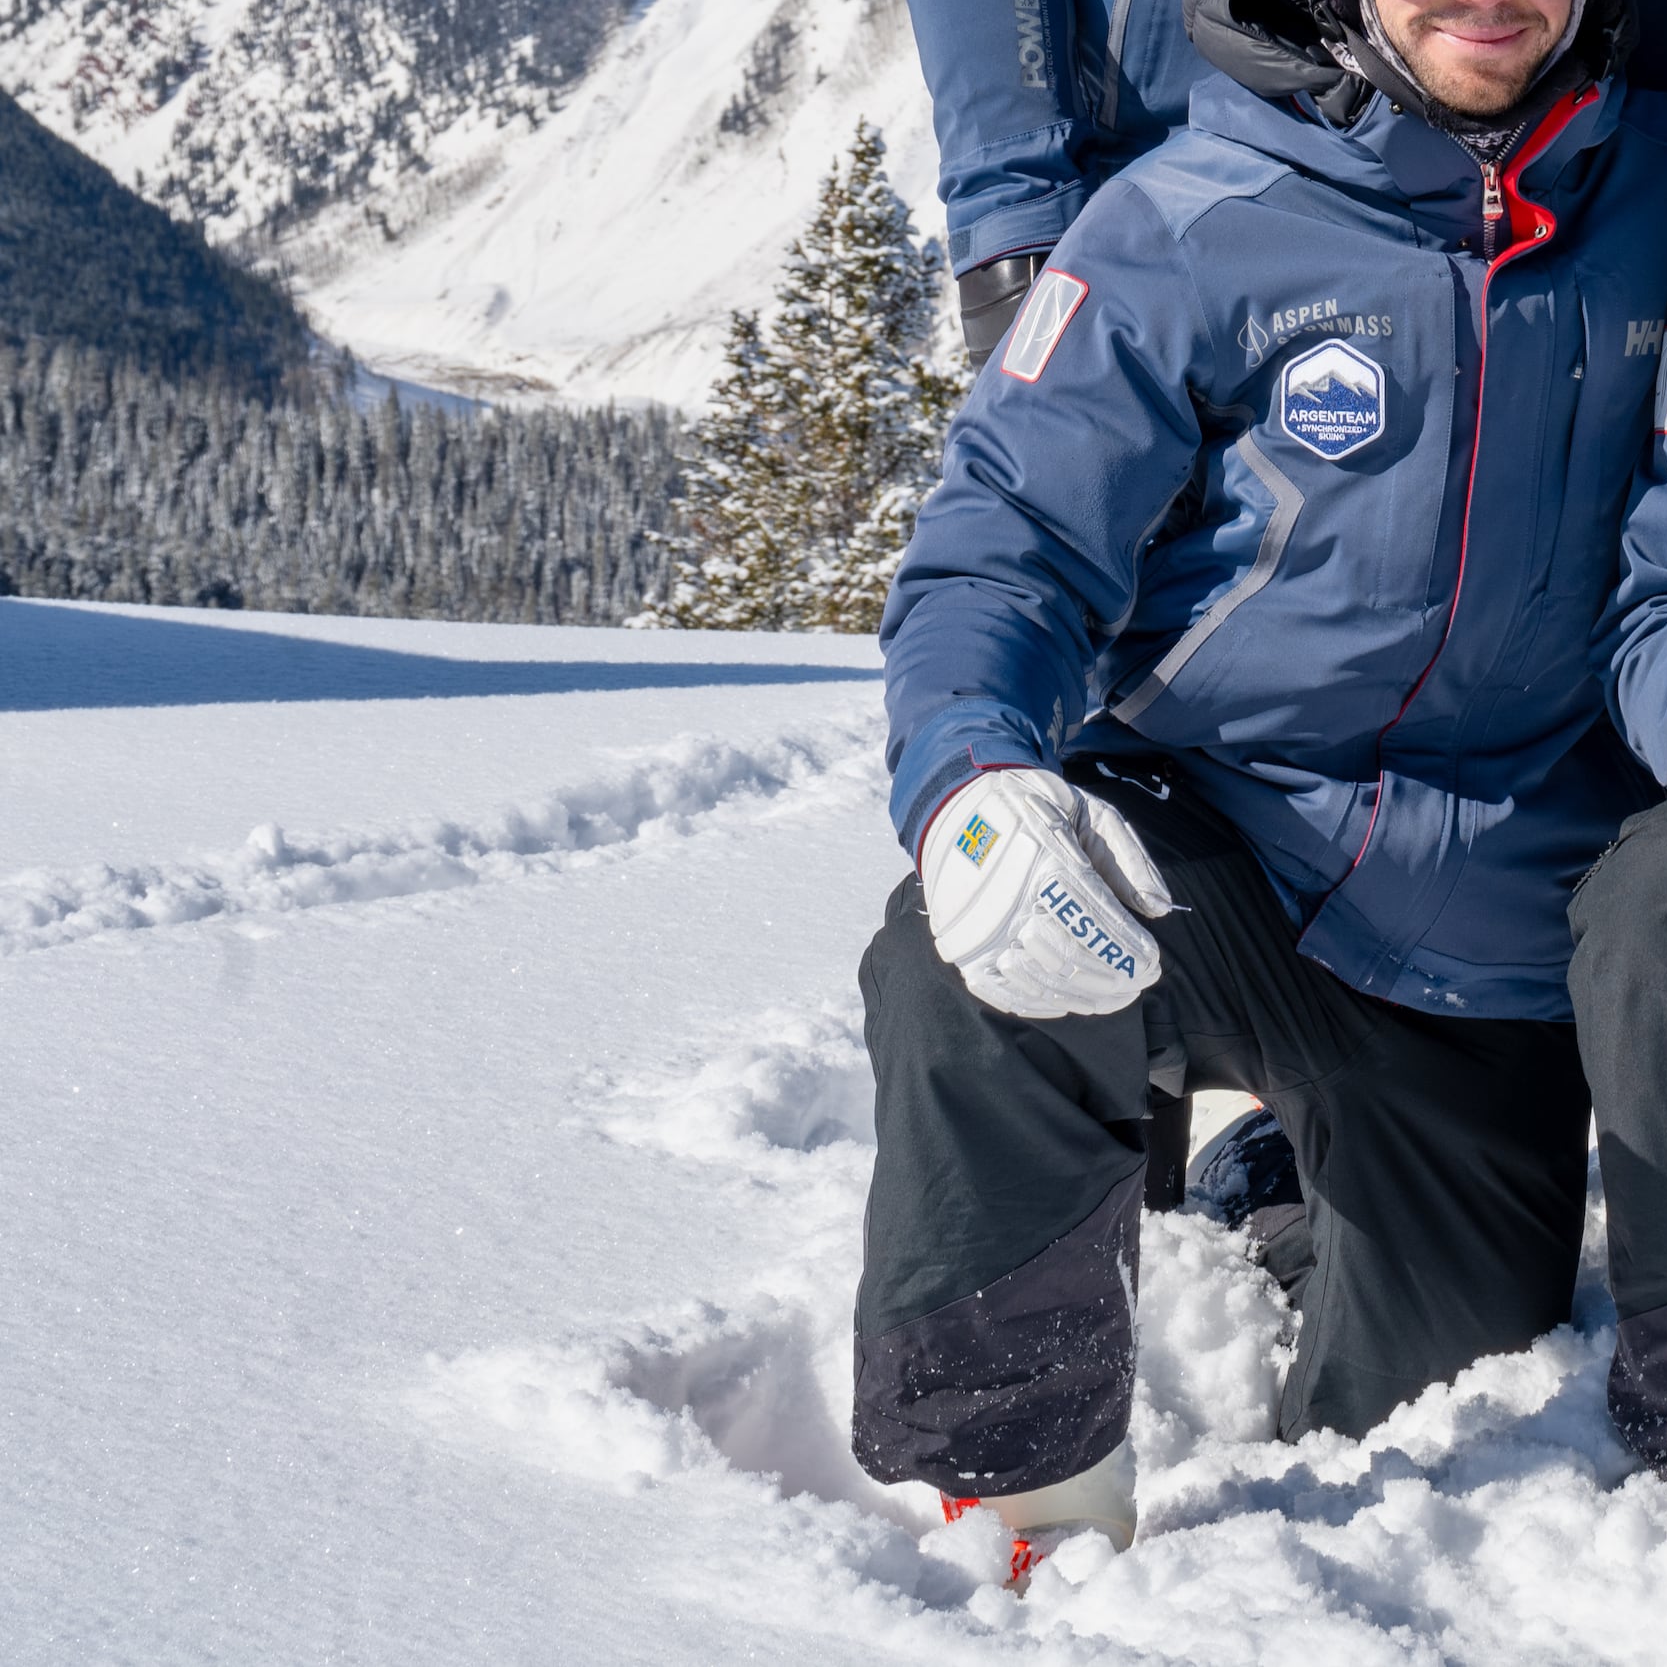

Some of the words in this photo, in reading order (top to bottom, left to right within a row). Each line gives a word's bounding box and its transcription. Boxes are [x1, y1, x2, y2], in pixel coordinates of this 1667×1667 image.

[1015, 10, 1047, 88] POW
[1273, 298, 1338, 334] ASPEN
[1288, 408, 1376, 425] ARGENTEAM
[1301, 424, 1363, 434] SYNCHRONIZED
[1040, 880, 1136, 979] HESTRA
